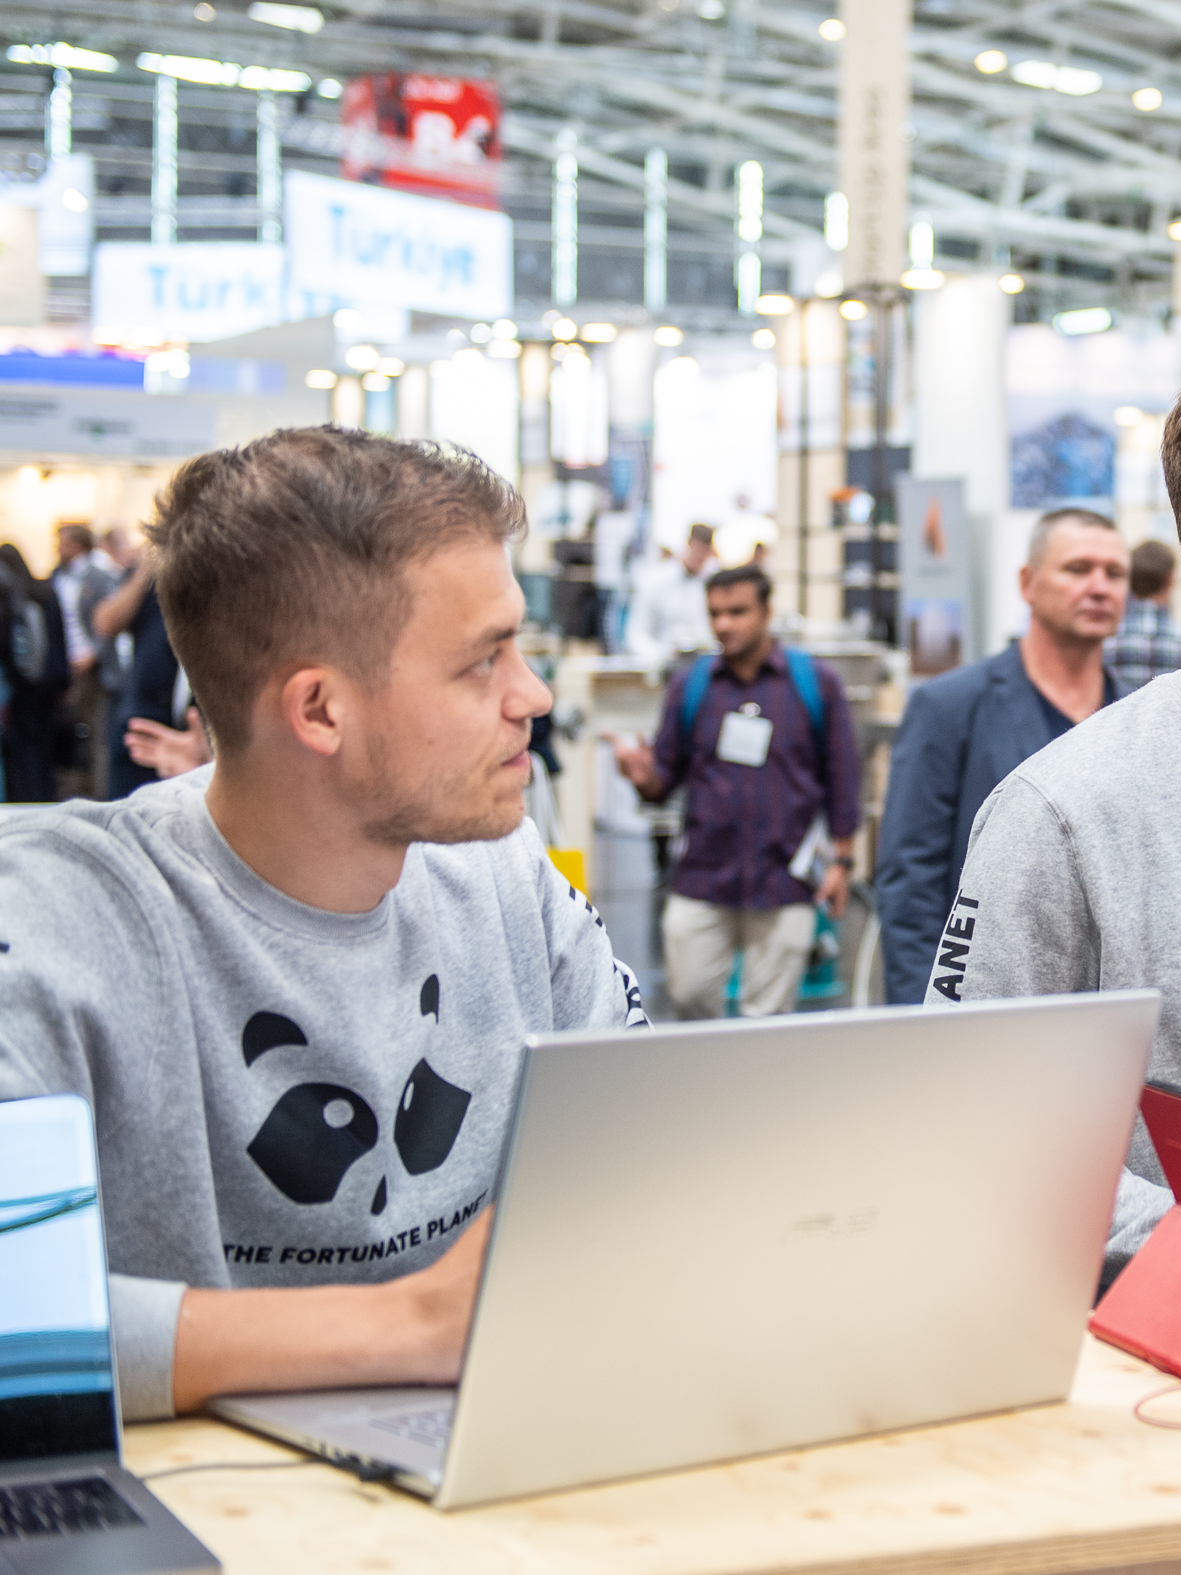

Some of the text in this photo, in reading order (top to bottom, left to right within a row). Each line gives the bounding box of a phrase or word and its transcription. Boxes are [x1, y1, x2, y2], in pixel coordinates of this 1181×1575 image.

[146, 264, 268, 310] Türk
[933, 888, 979, 1002] ANET
[223, 1244, 273, 1264] THE
[279, 1227, 422, 1265] FORTUNATE
